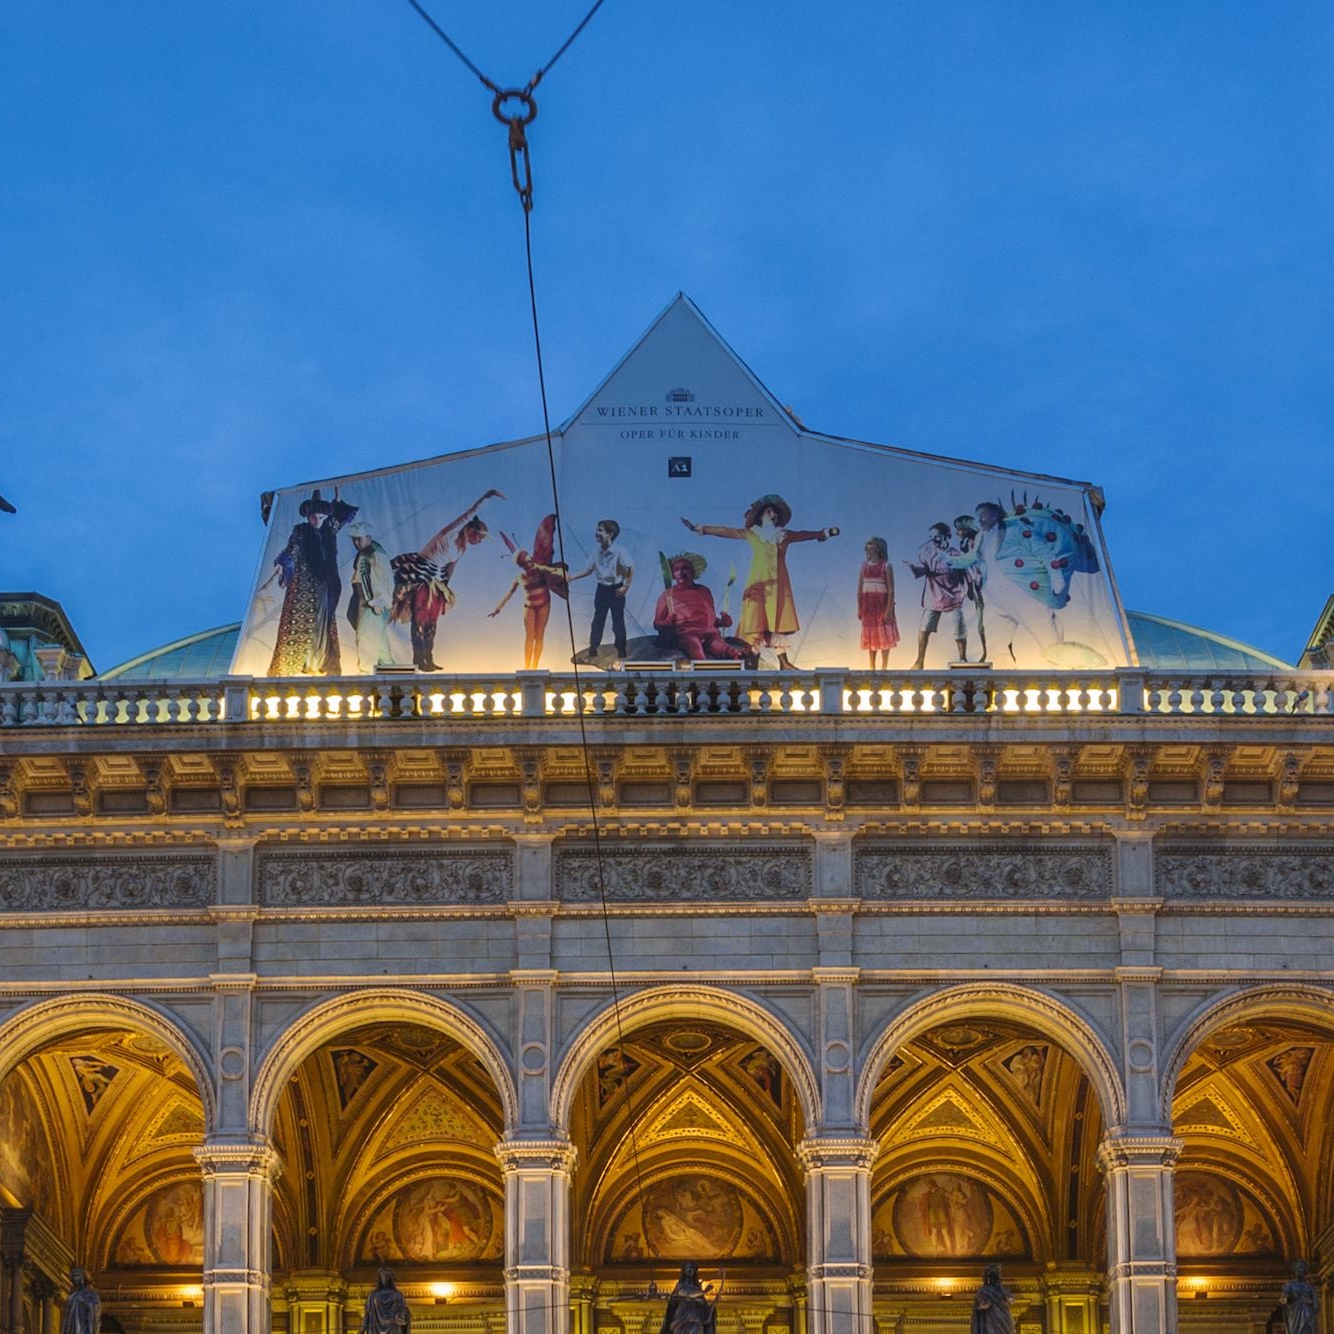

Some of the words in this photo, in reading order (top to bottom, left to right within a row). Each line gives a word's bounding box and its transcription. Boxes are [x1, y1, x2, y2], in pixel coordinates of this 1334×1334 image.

[597, 406, 658, 418] WIENER
[665, 405, 764, 418] STAATSOPER
[620, 430, 654, 440] OPER
[660, 428, 684, 439] FÜR
[690, 430, 740, 440] KINDER
